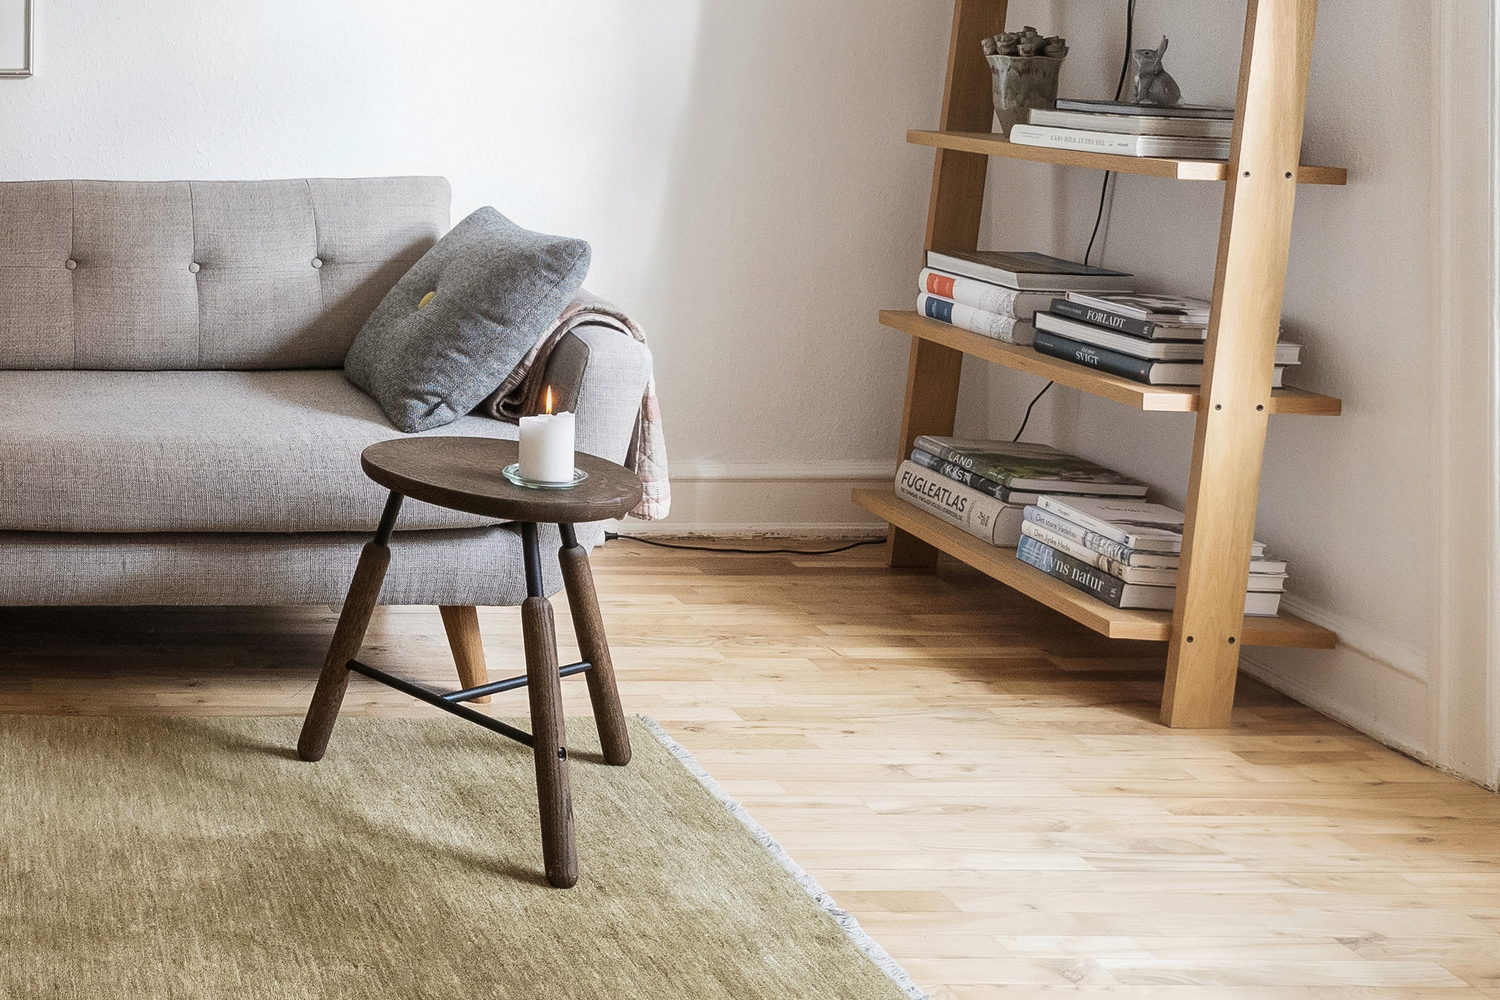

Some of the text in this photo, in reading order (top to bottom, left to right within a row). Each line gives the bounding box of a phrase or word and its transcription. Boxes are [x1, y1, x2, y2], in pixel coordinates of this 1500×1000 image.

[1086, 309, 1126, 328] FORLADT
[1075, 350, 1099, 366] SVIGT
[948, 451, 973, 468] LAND
[900, 471, 968, 513] FUGLEATLAS
[1042, 547, 1070, 576] Fyns
[1071, 567, 1105, 592] natur
